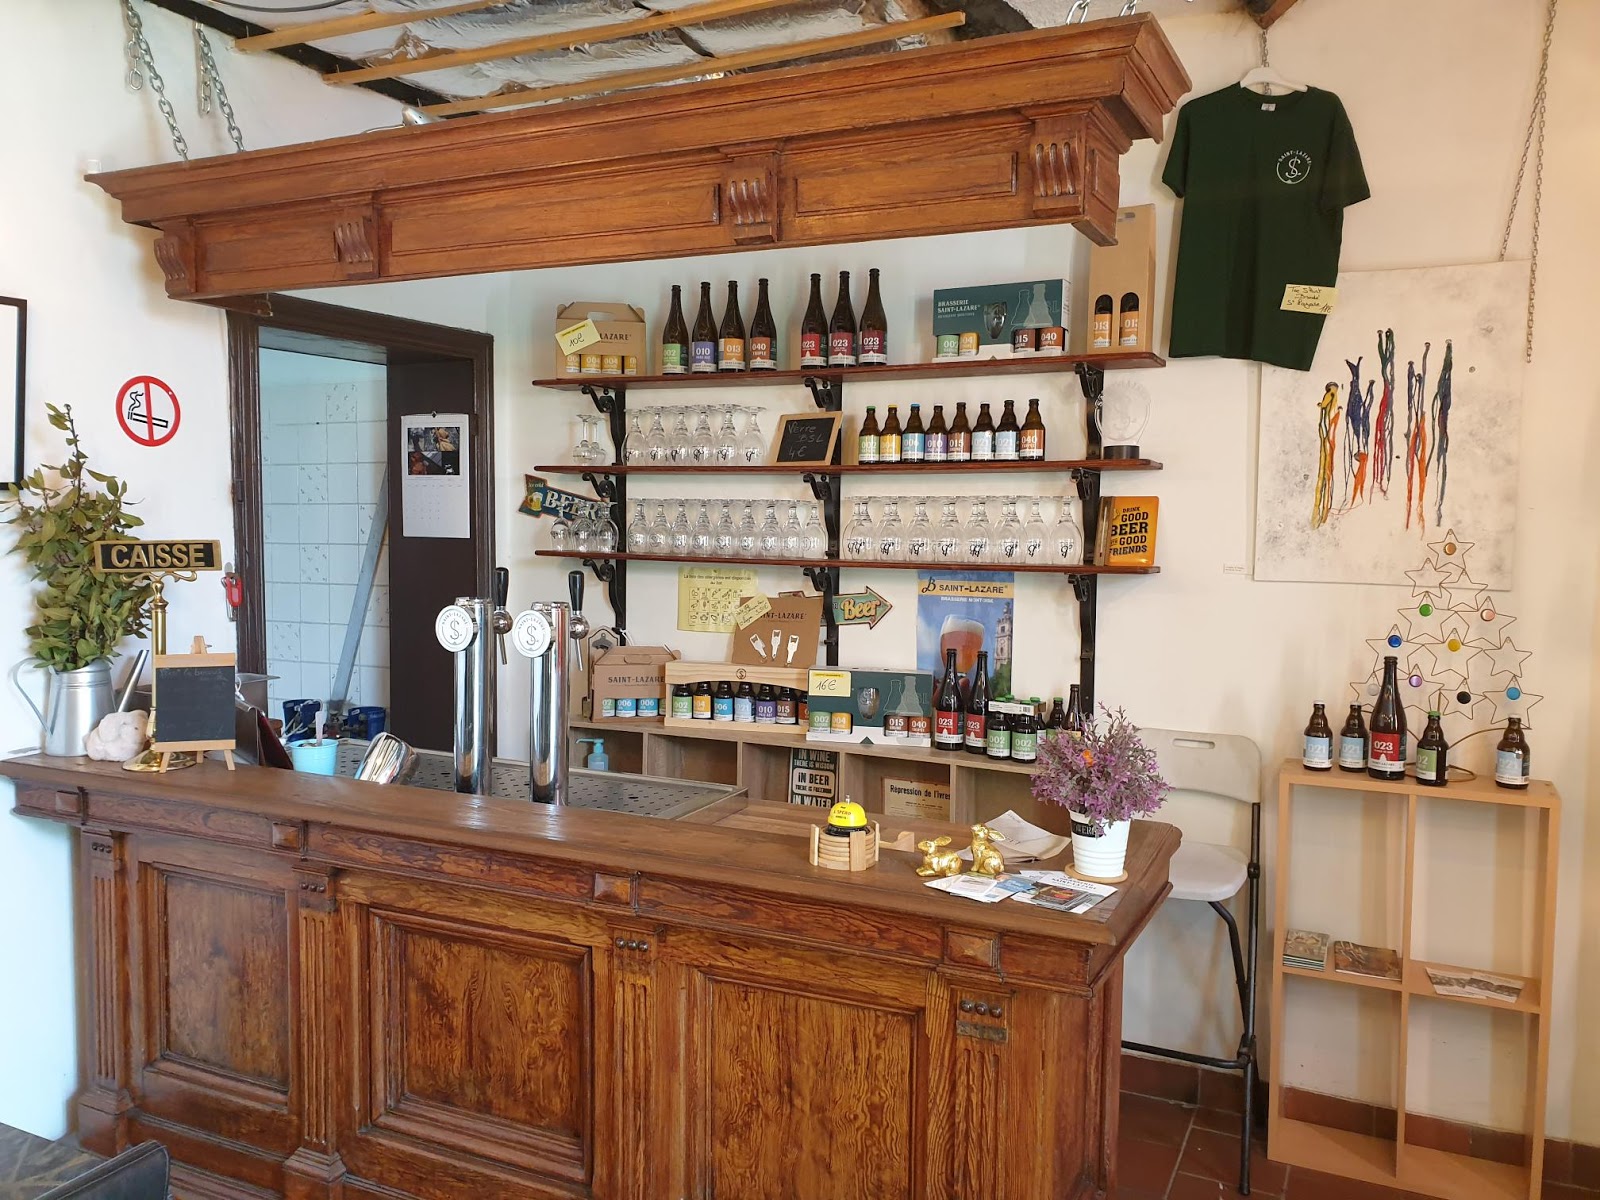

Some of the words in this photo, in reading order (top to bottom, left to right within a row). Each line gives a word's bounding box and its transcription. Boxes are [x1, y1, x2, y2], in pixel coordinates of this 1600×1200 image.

[599, 333, 629, 341] LAZARE
[863, 336, 880, 346] 023
[1040, 332, 1057, 342] 040
[751, 343, 767, 351] 040
[803, 340, 816, 348] 023
[832, 339, 849, 348] 023
[696, 347, 711, 356] 010
[726, 344, 741, 353] 013
[927, 439, 943, 448] 010
[949, 439, 963, 448] 015
[1021, 435, 1037, 444] 040
[862, 441, 877, 449] 002
[544, 489, 601, 521] BEER
[1121, 512, 1149, 522] GOOD
[1111, 522, 1149, 536] BEER
[1119, 535, 1147, 545] GOOD
[1109, 545, 1148, 556] FRIENDS
[111, 544, 206, 569] CAISSE
[840, 597, 881, 621] Beer
[816, 679, 836, 691] 16€
[758, 705, 773, 714] 010
[777, 705, 790, 714] 015
[814, 715, 829, 723] 002
[889, 718, 904, 727] 015
[938, 717, 954, 726] 023
[911, 720, 927, 728] 040
[966, 720, 981, 729] 023
[989, 735, 1005, 745] 002
[1015, 739, 1032, 748] 002
[1373, 740, 1393, 751] 023
[809, 774, 830, 786] BEER
[924, 789, 932, 798] de
[803, 795, 832, 809] WATER
